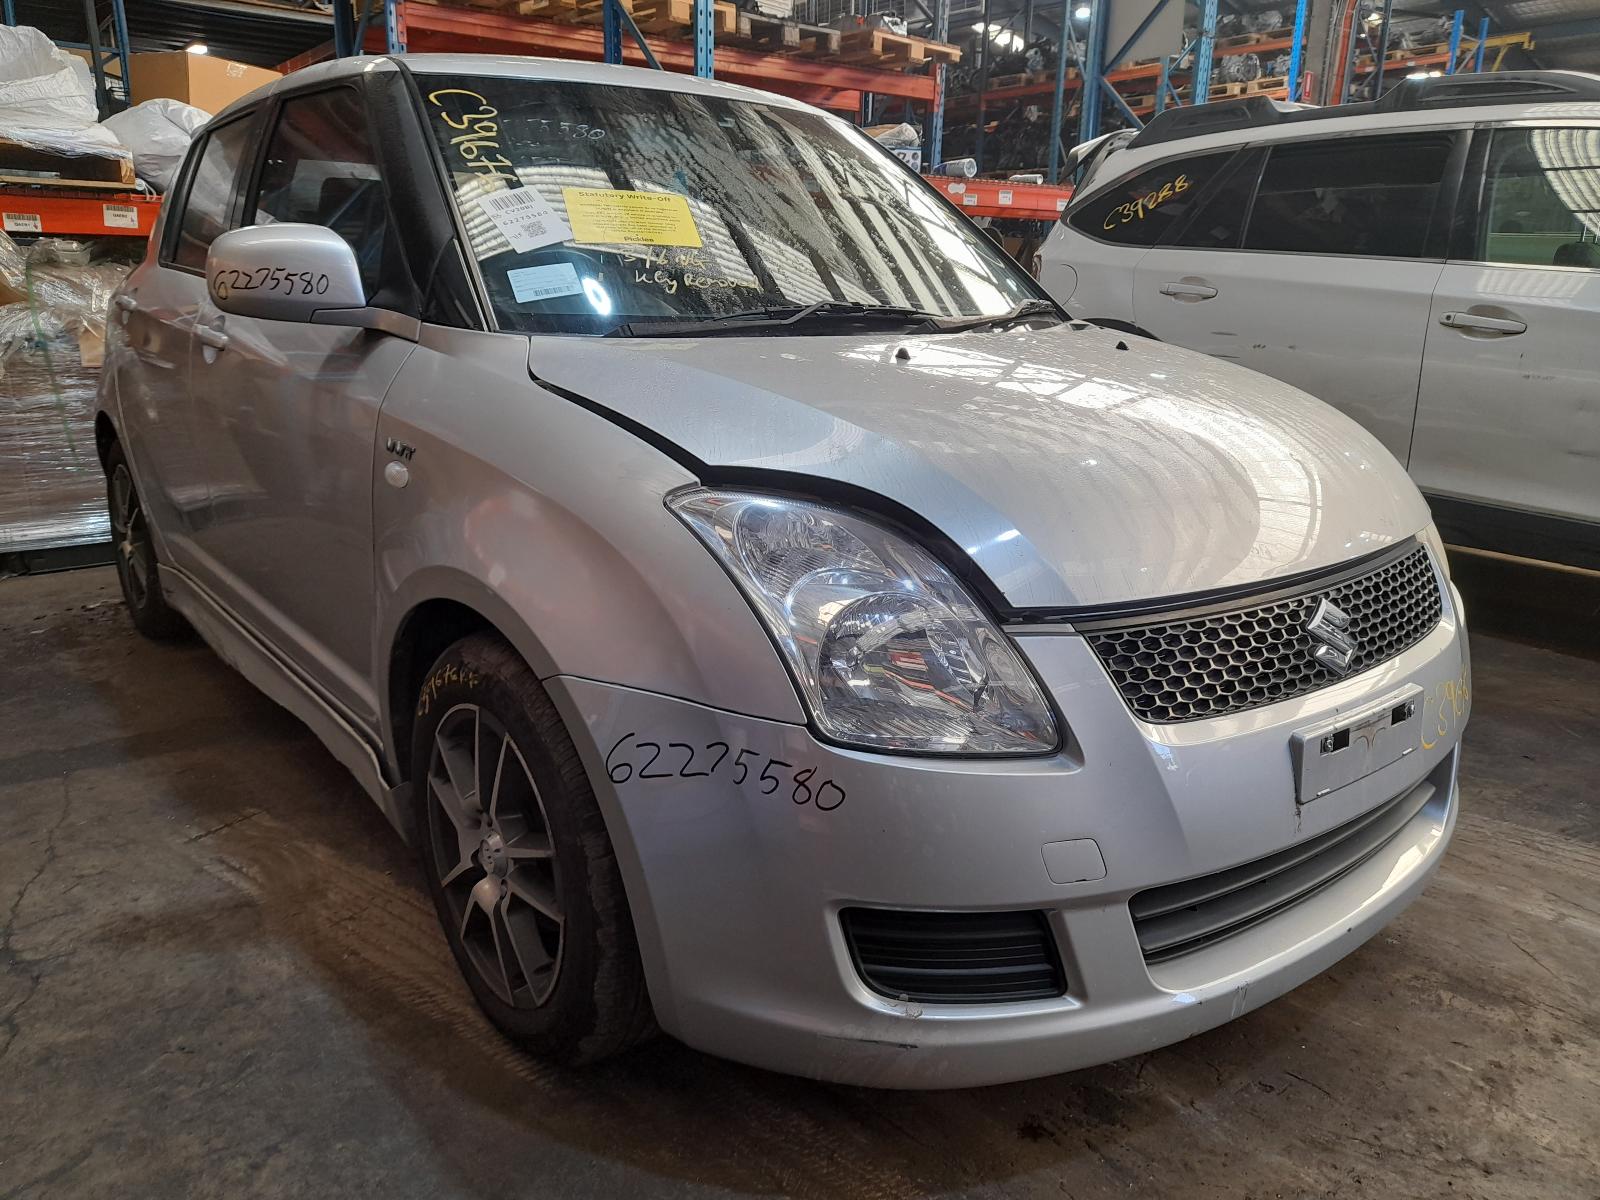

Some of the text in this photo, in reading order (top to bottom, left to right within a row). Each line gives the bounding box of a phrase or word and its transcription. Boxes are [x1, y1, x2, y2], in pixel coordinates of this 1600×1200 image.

[578, 191, 672, 202] Statutory Write-Off
[213, 267, 330, 300] 62275580
[605, 732, 846, 812] 62275580
